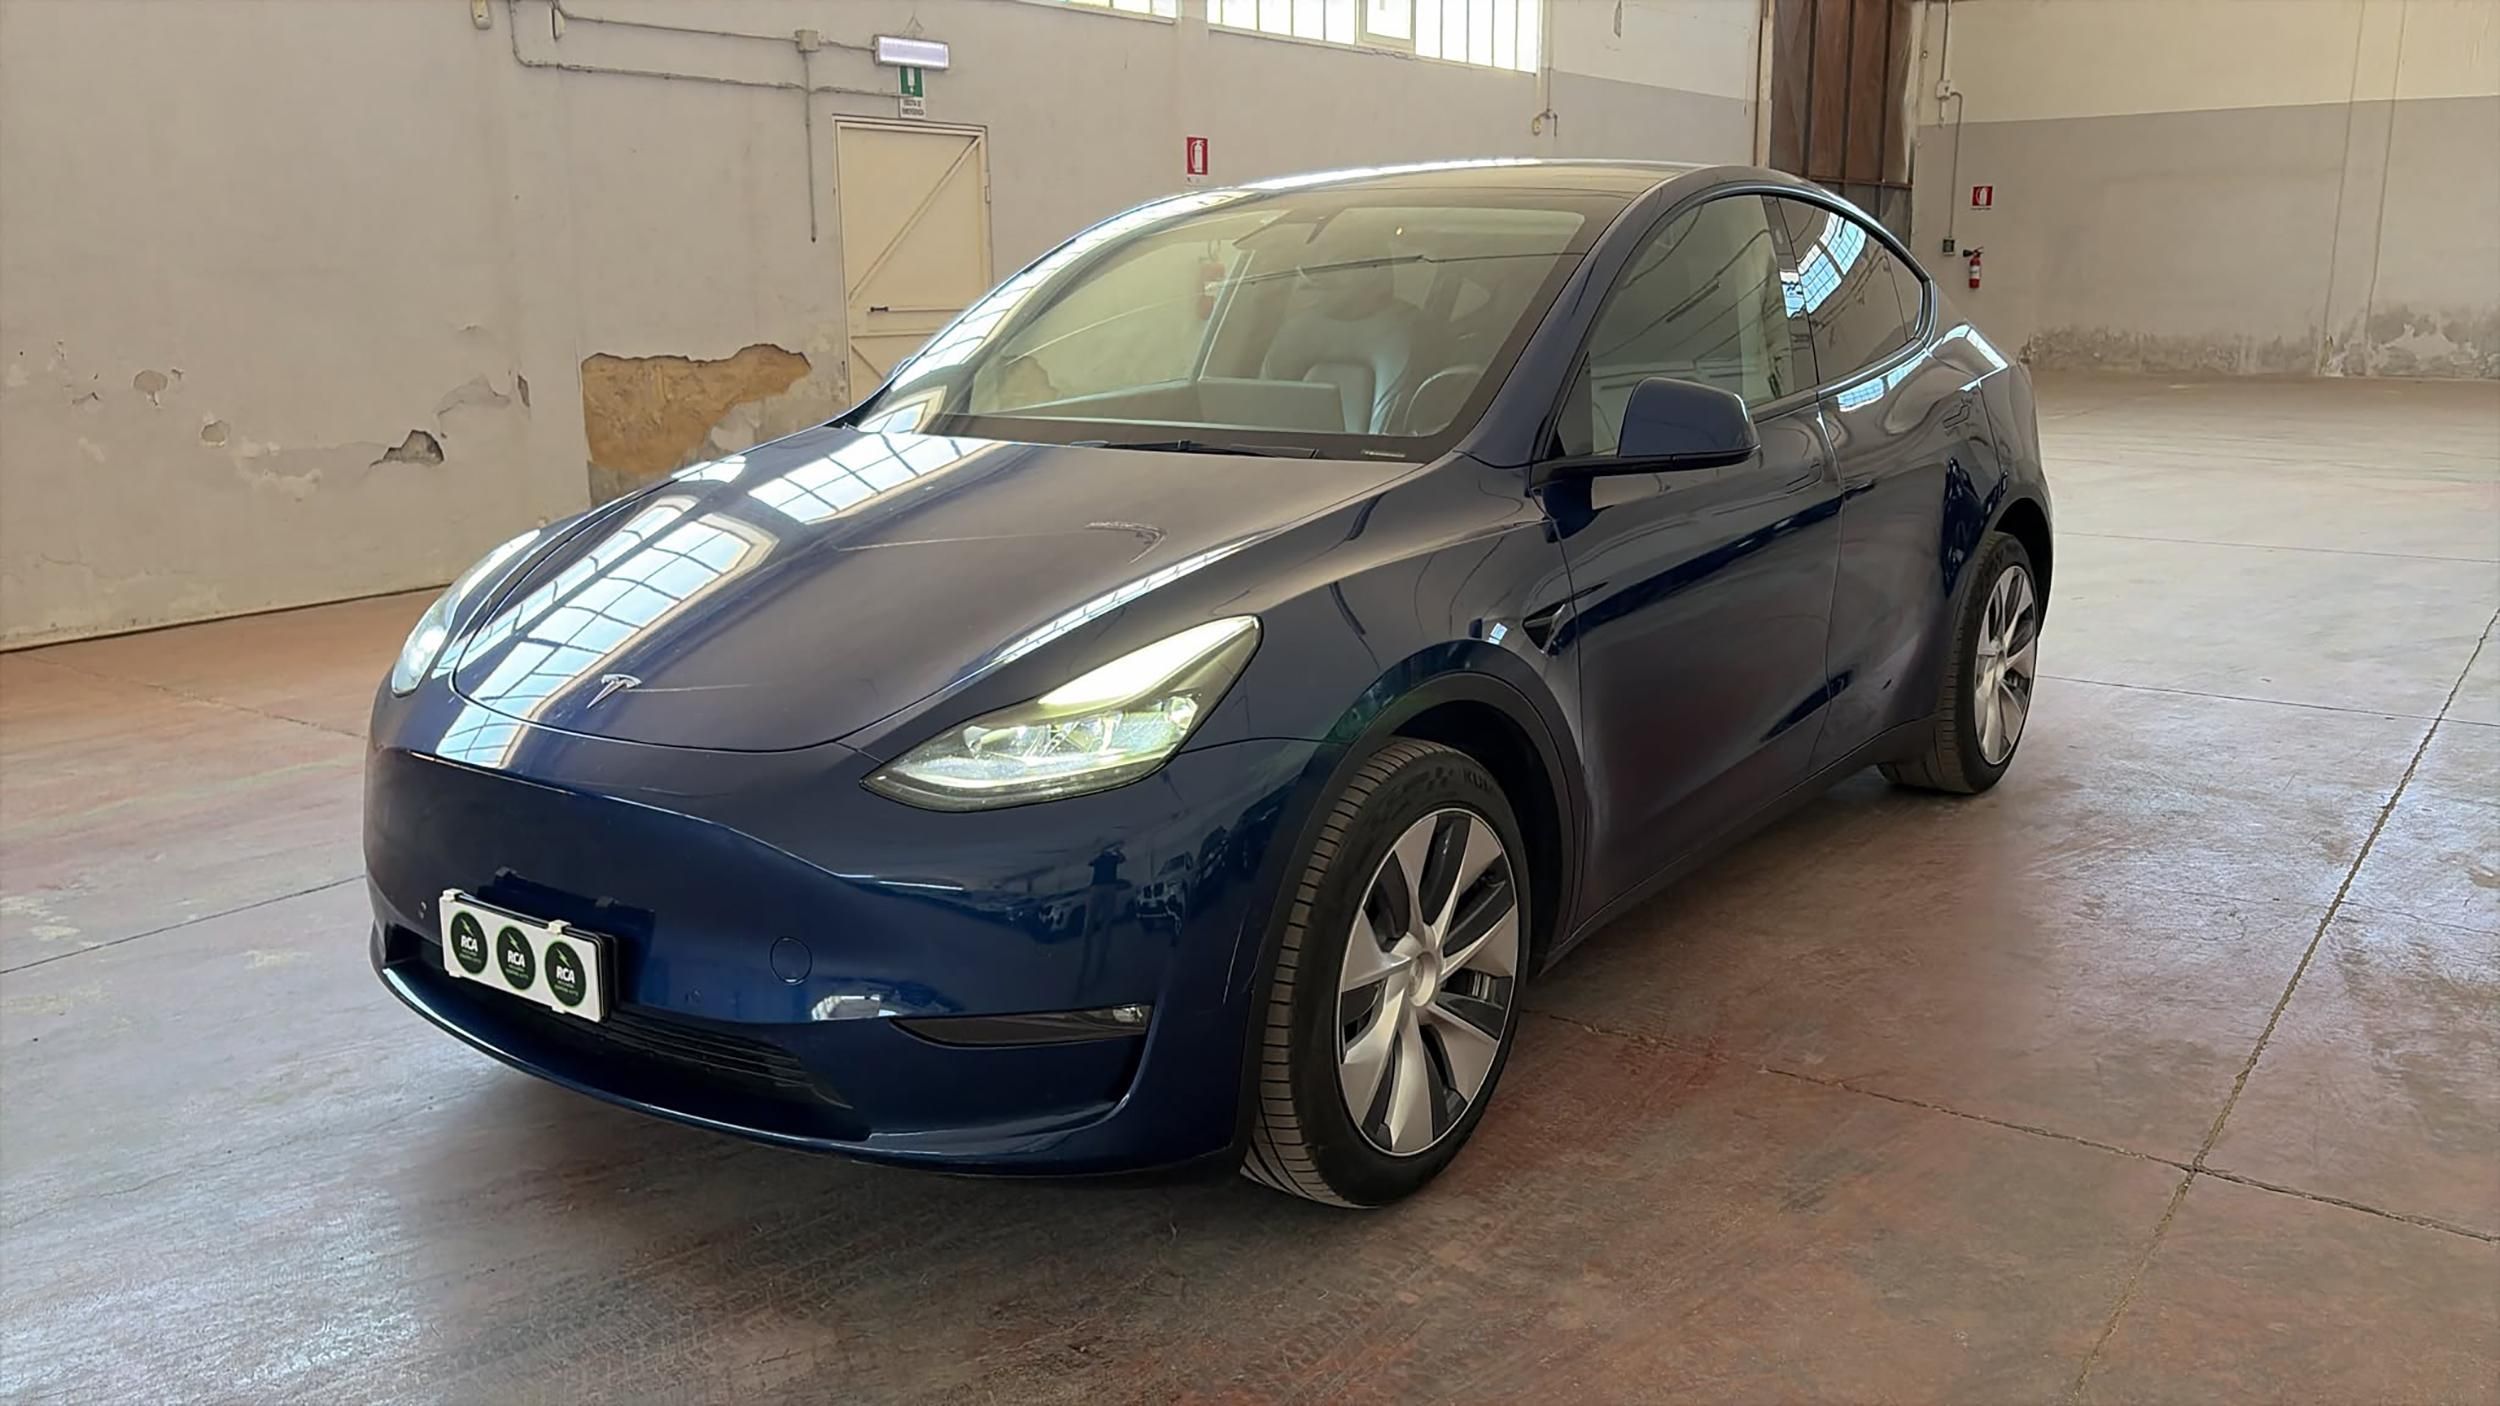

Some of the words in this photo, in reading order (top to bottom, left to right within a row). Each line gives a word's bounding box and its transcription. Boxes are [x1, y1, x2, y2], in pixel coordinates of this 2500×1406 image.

[461, 935, 478, 952] RCA
[507, 950, 526, 968] RCA
[556, 965, 575, 984] RCA
